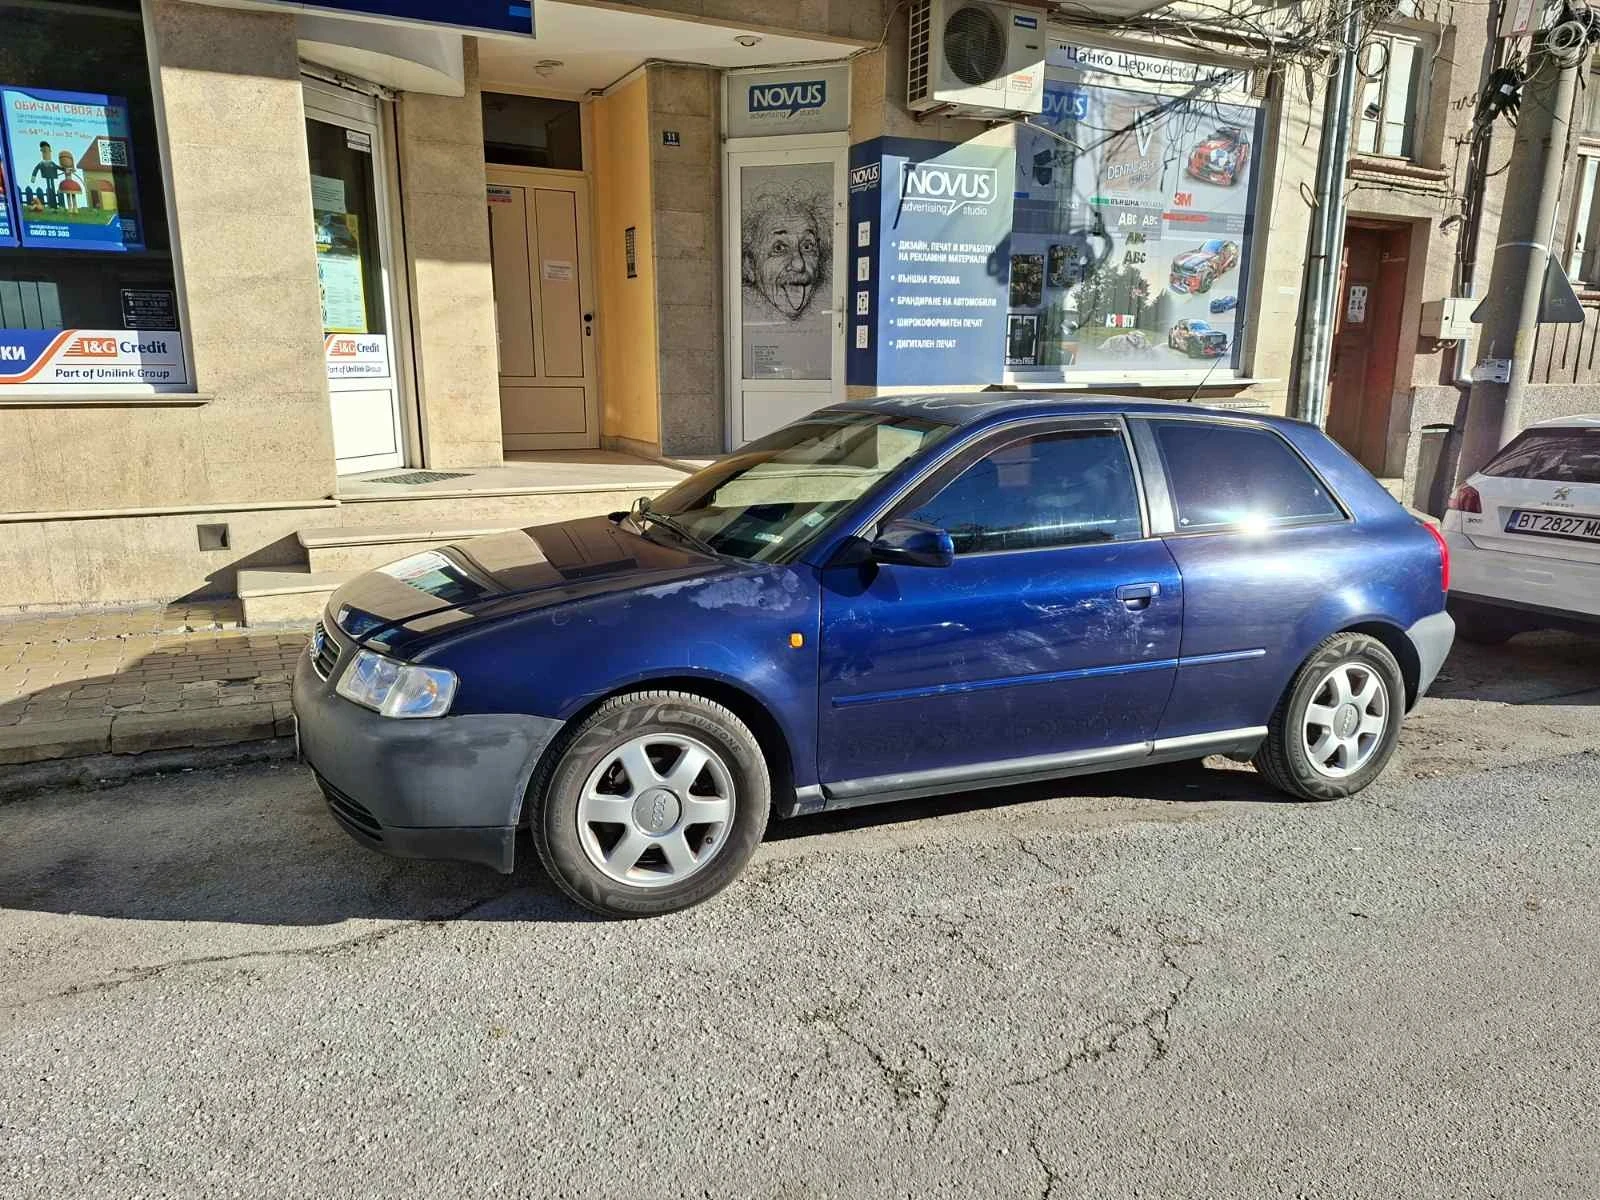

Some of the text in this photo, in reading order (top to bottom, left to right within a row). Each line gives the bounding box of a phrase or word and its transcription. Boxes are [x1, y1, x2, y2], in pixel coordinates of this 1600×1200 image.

[753, 84, 821, 108] NOVUS
[15, 101, 61, 113] ОБИЧАМ
[63, 104, 94, 117] СВОЯ
[853, 165, 879, 185] NOVUS
[906, 170, 990, 199] NOVUS
[1173, 193, 1192, 207] 3M
[902, 201, 988, 216] advertising studio
[899, 240, 930, 252] ДИЗАЙН,
[931, 242, 952, 252] ПЕЧАТ
[898, 252, 987, 264] НА РЕКЛАМНИ МАТЕРИАЛИ
[898, 274, 960, 285] ВЪНШНА РЕКЛАМА
[897, 296, 997, 307] БРАНДИРАНЕ НА АВТОМОБИЛИ
[897, 318, 984, 328] ШИРОКОФОРМАТЕН ПЕЧАТ
[119, 340, 168, 355] Credit
[356, 342, 380, 353] Credit
[896, 339, 957, 349] ДИГИТАЛЕН ПЕЧАТ
[55, 368, 170, 380] Part of Unilink Group
[1518, 513, 1542, 530] BT
[1540, 516, 1584, 533] 2827
